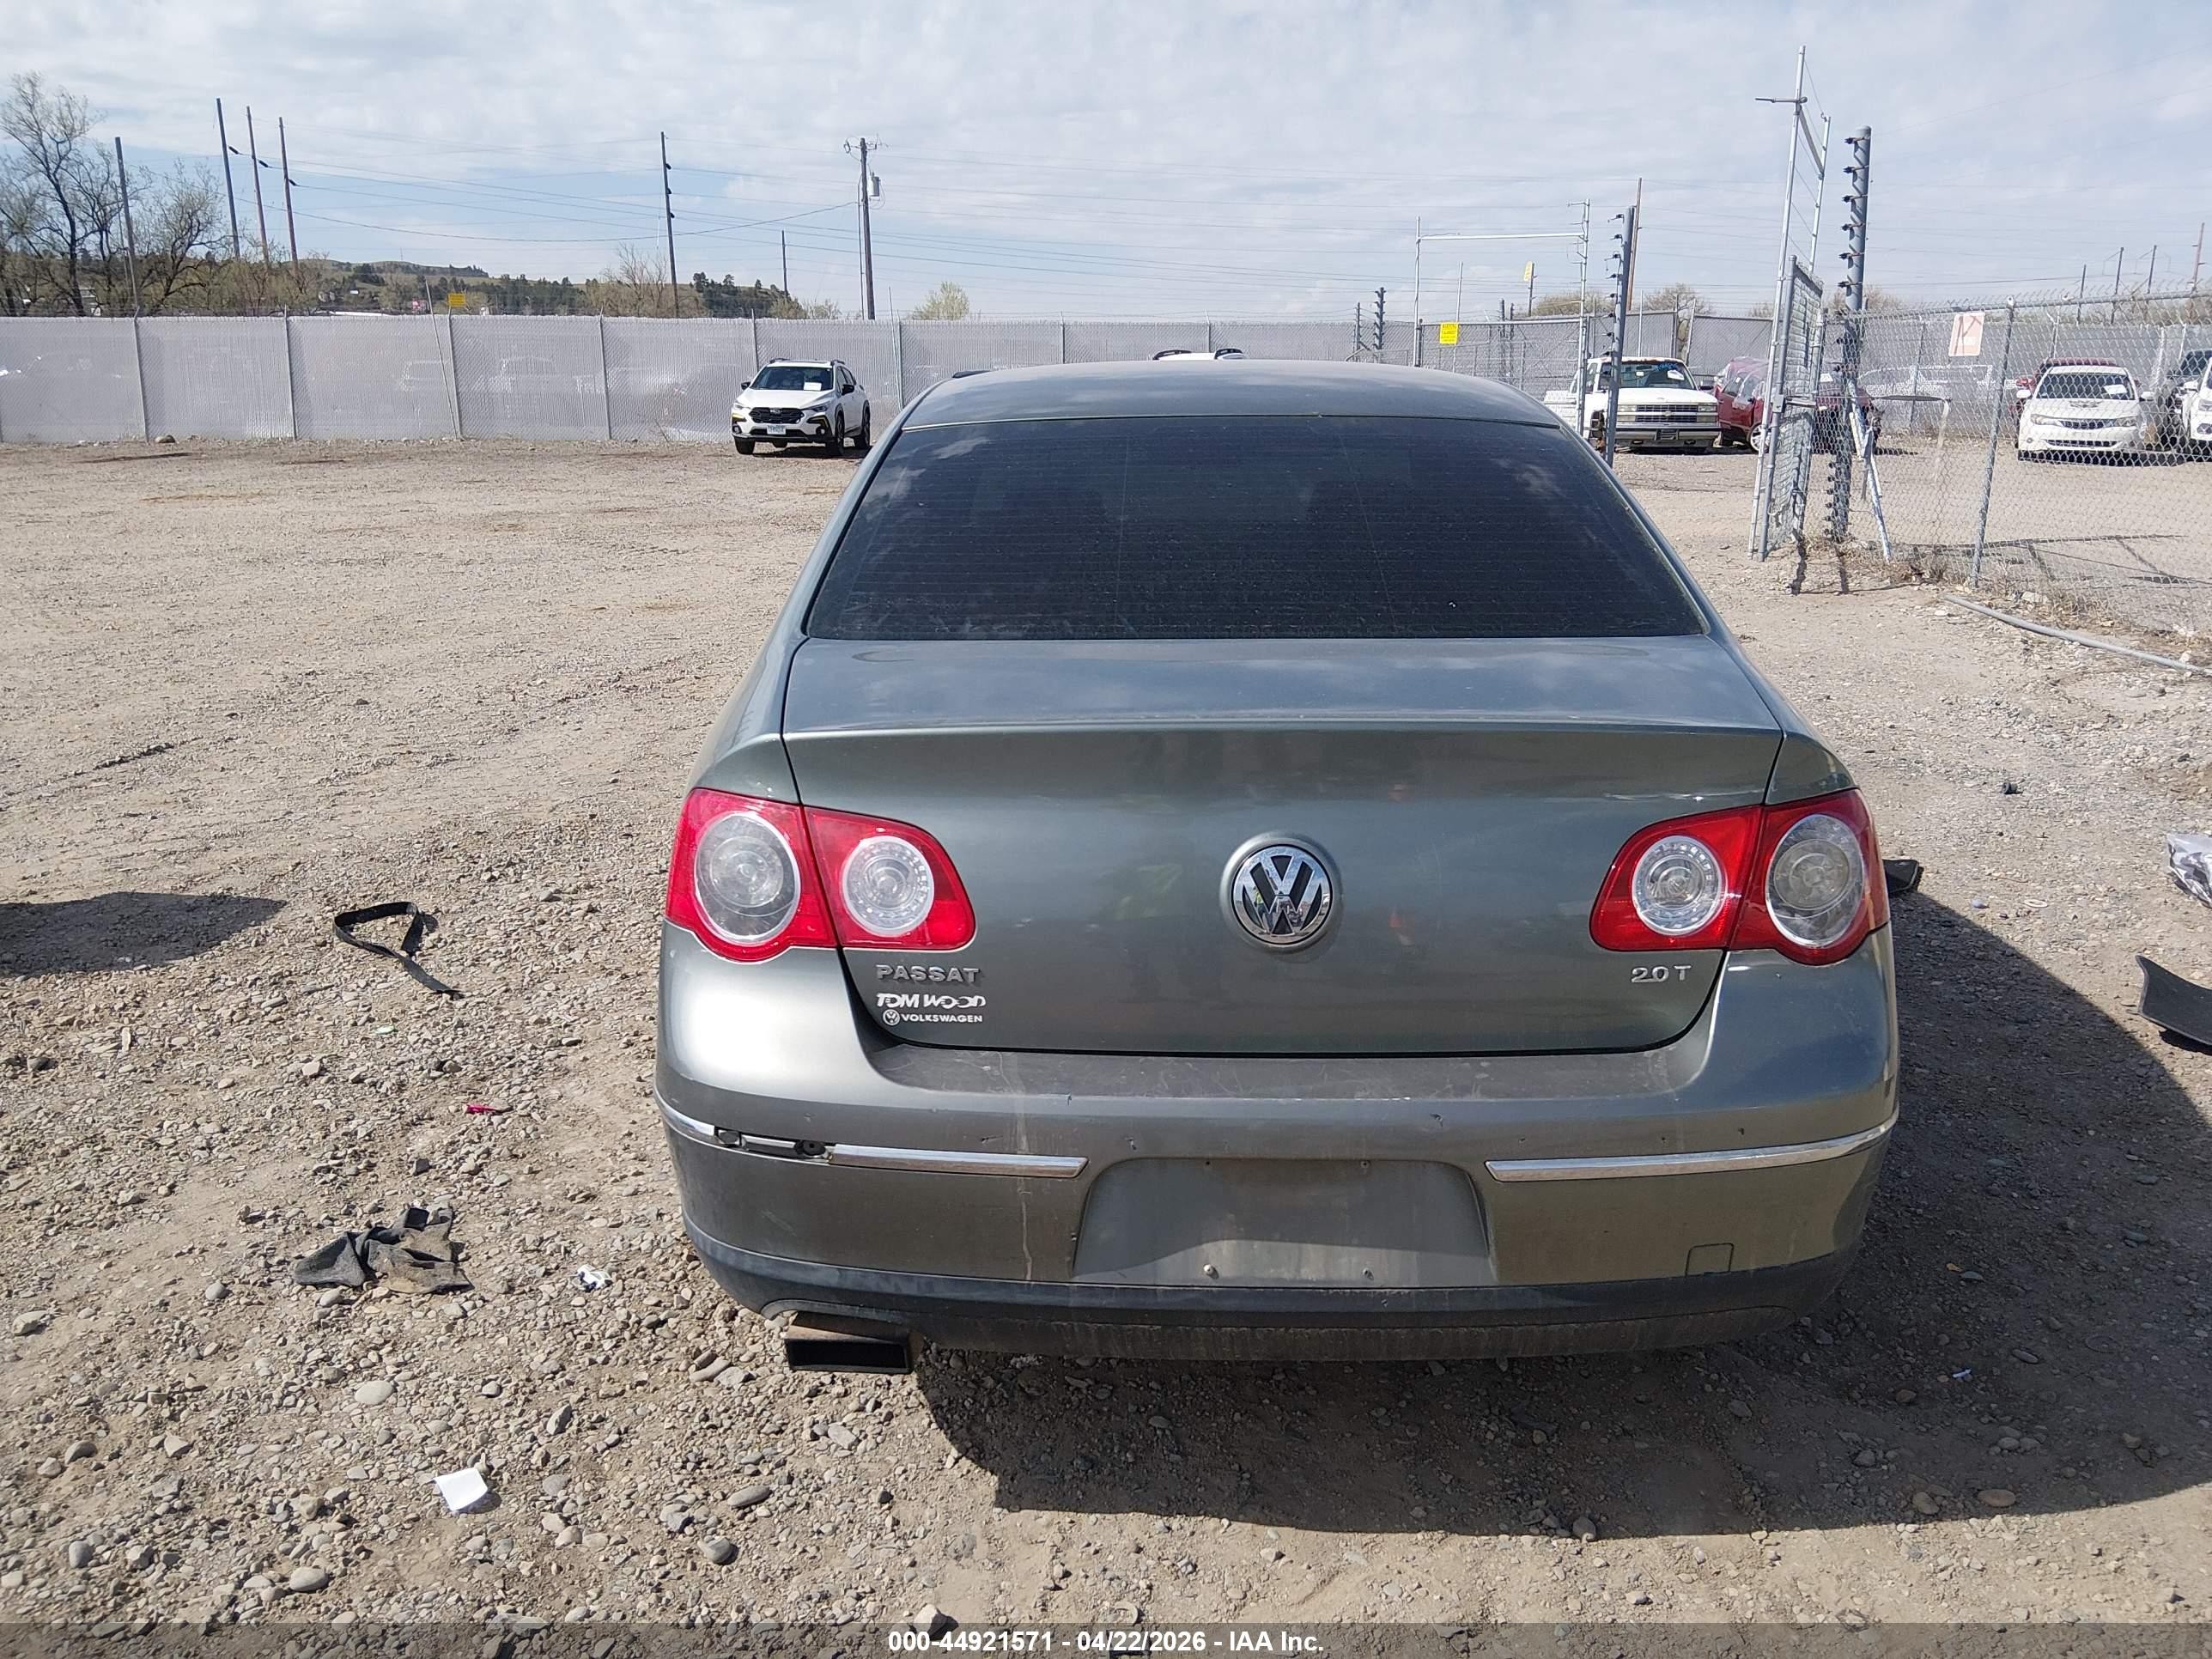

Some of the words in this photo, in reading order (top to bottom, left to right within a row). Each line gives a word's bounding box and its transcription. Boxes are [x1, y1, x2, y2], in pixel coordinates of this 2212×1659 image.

[876, 964, 980, 982] PASSAT
[876, 993, 920, 1008] TOM
[923, 994, 986, 1009] WOOD
[902, 1013, 983, 1023] VOLKSWAGEN
